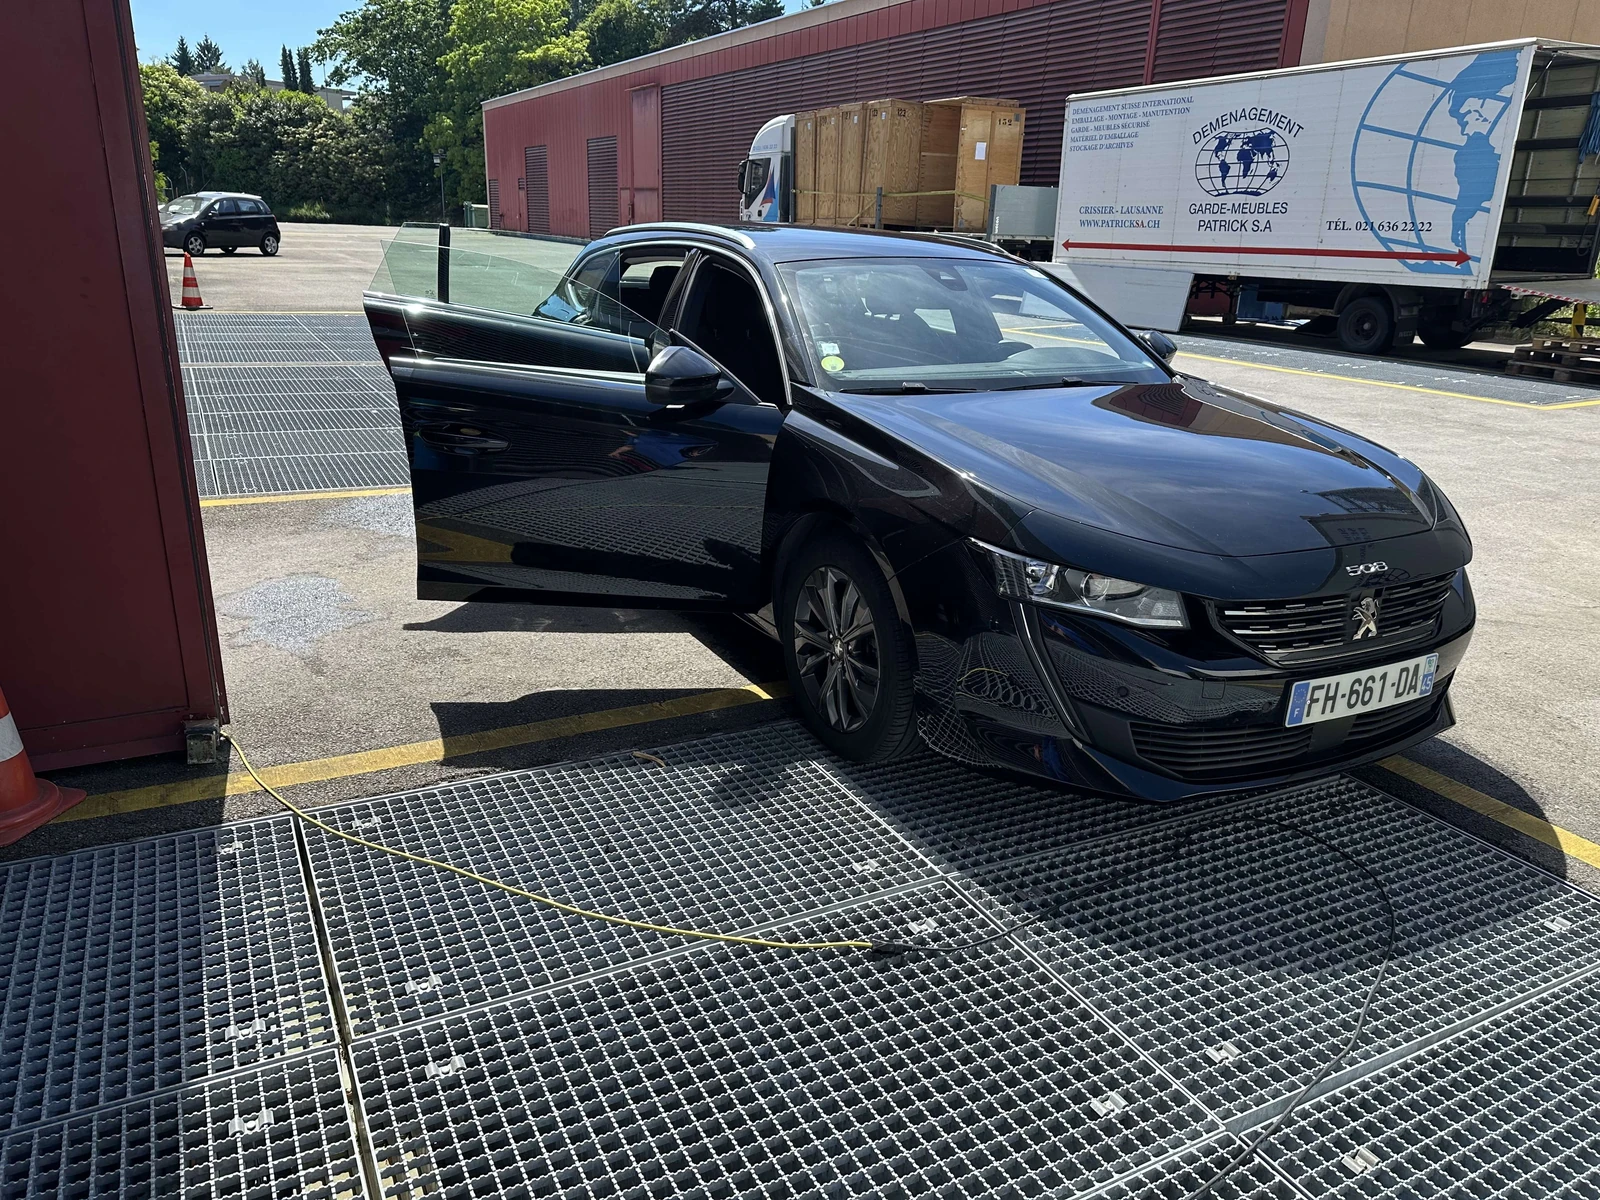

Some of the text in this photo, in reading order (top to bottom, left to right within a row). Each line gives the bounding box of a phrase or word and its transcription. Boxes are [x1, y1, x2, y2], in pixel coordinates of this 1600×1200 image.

[1121, 101, 1142, 111] SUISSE
[1142, 96, 1194, 108] INTERNATIONAL
[1072, 114, 1104, 125] EMBALLAGE
[1108, 111, 1138, 122] MONTAGE
[1142, 106, 1191, 118] MANUTENTION
[1071, 126, 1090, 134] GARDE
[1093, 123, 1120, 132] MEUBLES
[1121, 120, 1151, 130] SÉCURISÉ
[1192, 106, 1304, 145] DEMENAGEMENT
[1070, 131, 1139, 143] MATÉRIEL D'EMBALLAGE
[1069, 141, 1134, 152] STOCKAGE D'ARCHIVES
[1079, 206, 1115, 215] CRISSIER
[1120, 205, 1164, 215] LAUSANNE
[1188, 202, 1289, 215] GARDE-MEUBLES
[1079, 219, 1160, 229] WWW.PATRICKSA.CH
[1197, 219, 1272, 233] PATRICK S.A
[1326, 218, 1433, 232] TÉL. 021 636 22 22
[1345, 561, 1389, 577] 508
[1305, 663, 1420, 718] FH-661-DA
[1421, 676, 1432, 692] 45
[1293, 708, 1300, 718] F
